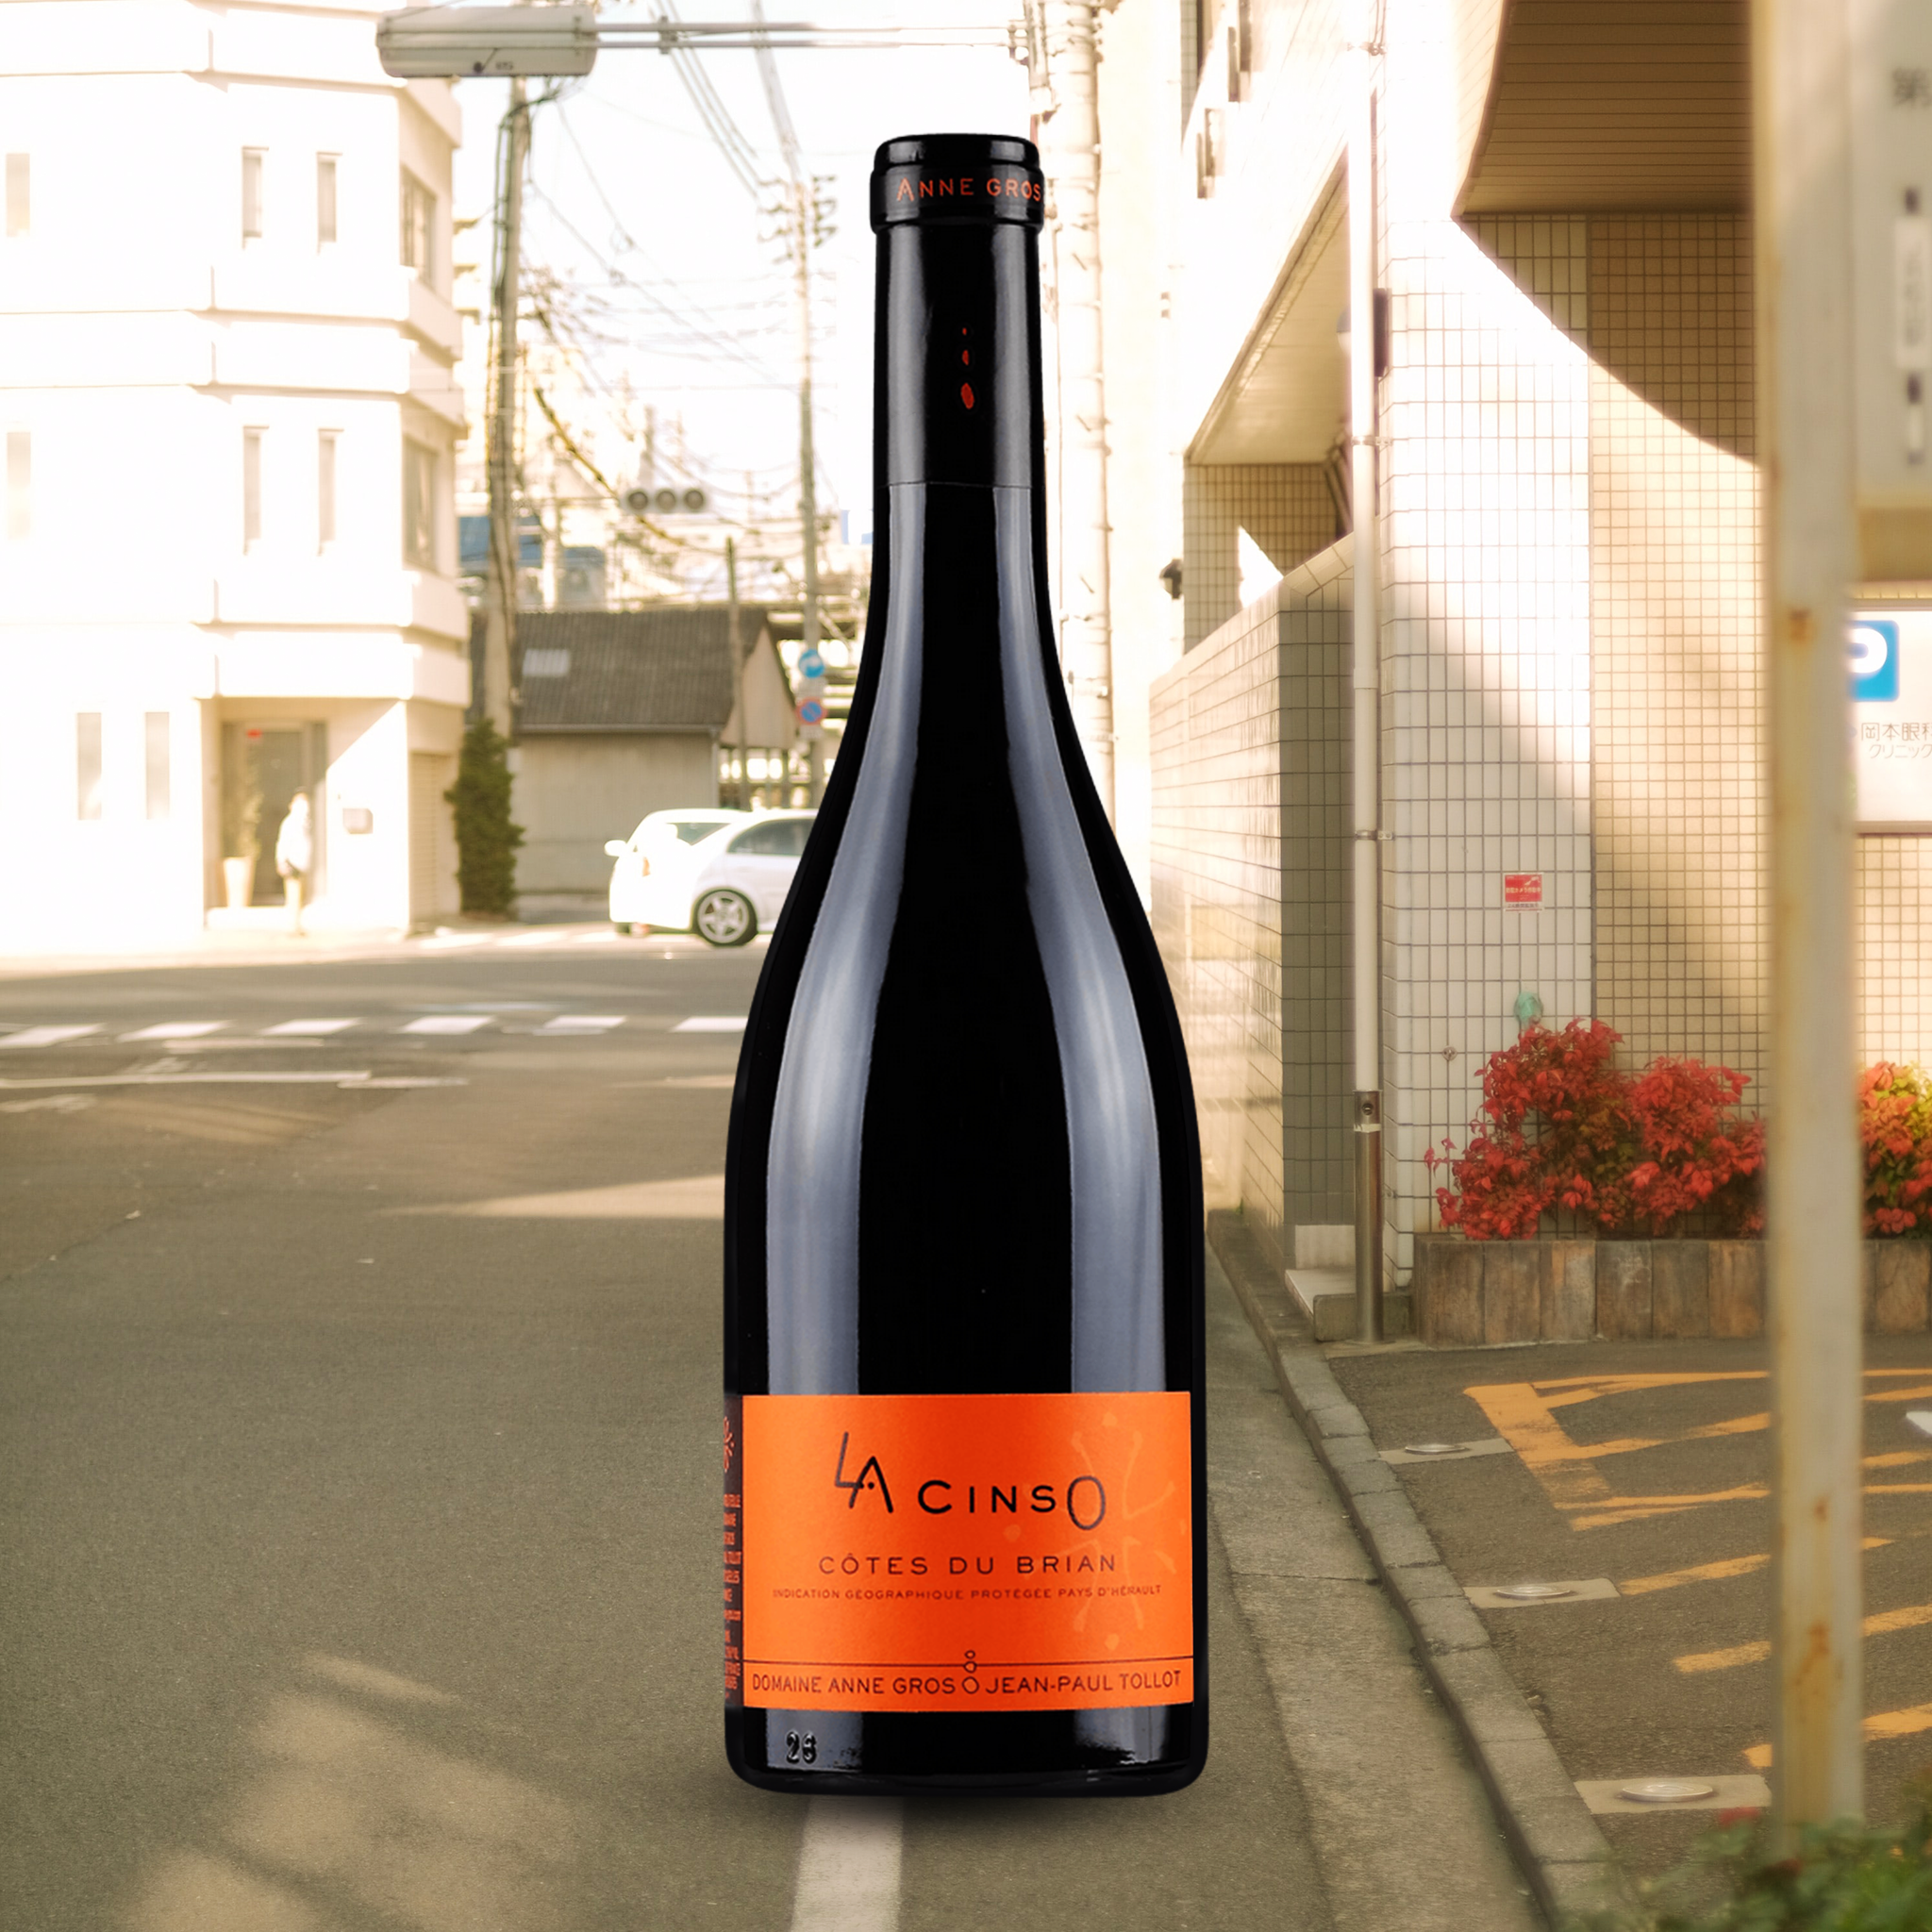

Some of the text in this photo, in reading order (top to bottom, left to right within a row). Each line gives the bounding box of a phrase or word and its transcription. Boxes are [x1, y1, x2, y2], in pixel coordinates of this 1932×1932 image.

[897, 176, 1041, 201] ANNE GROS
[835, 1431, 1106, 1530] LA CINSO
[819, 1553, 1116, 1575] CÔTES DU BRIAN
[773, 1589, 840, 1599] INDICATION
[1058, 1587, 1093, 1598] PAYS
[753, 1670, 1181, 1694] DOMAINE ANNE GROS JEAN-PAUL TOLLOT
